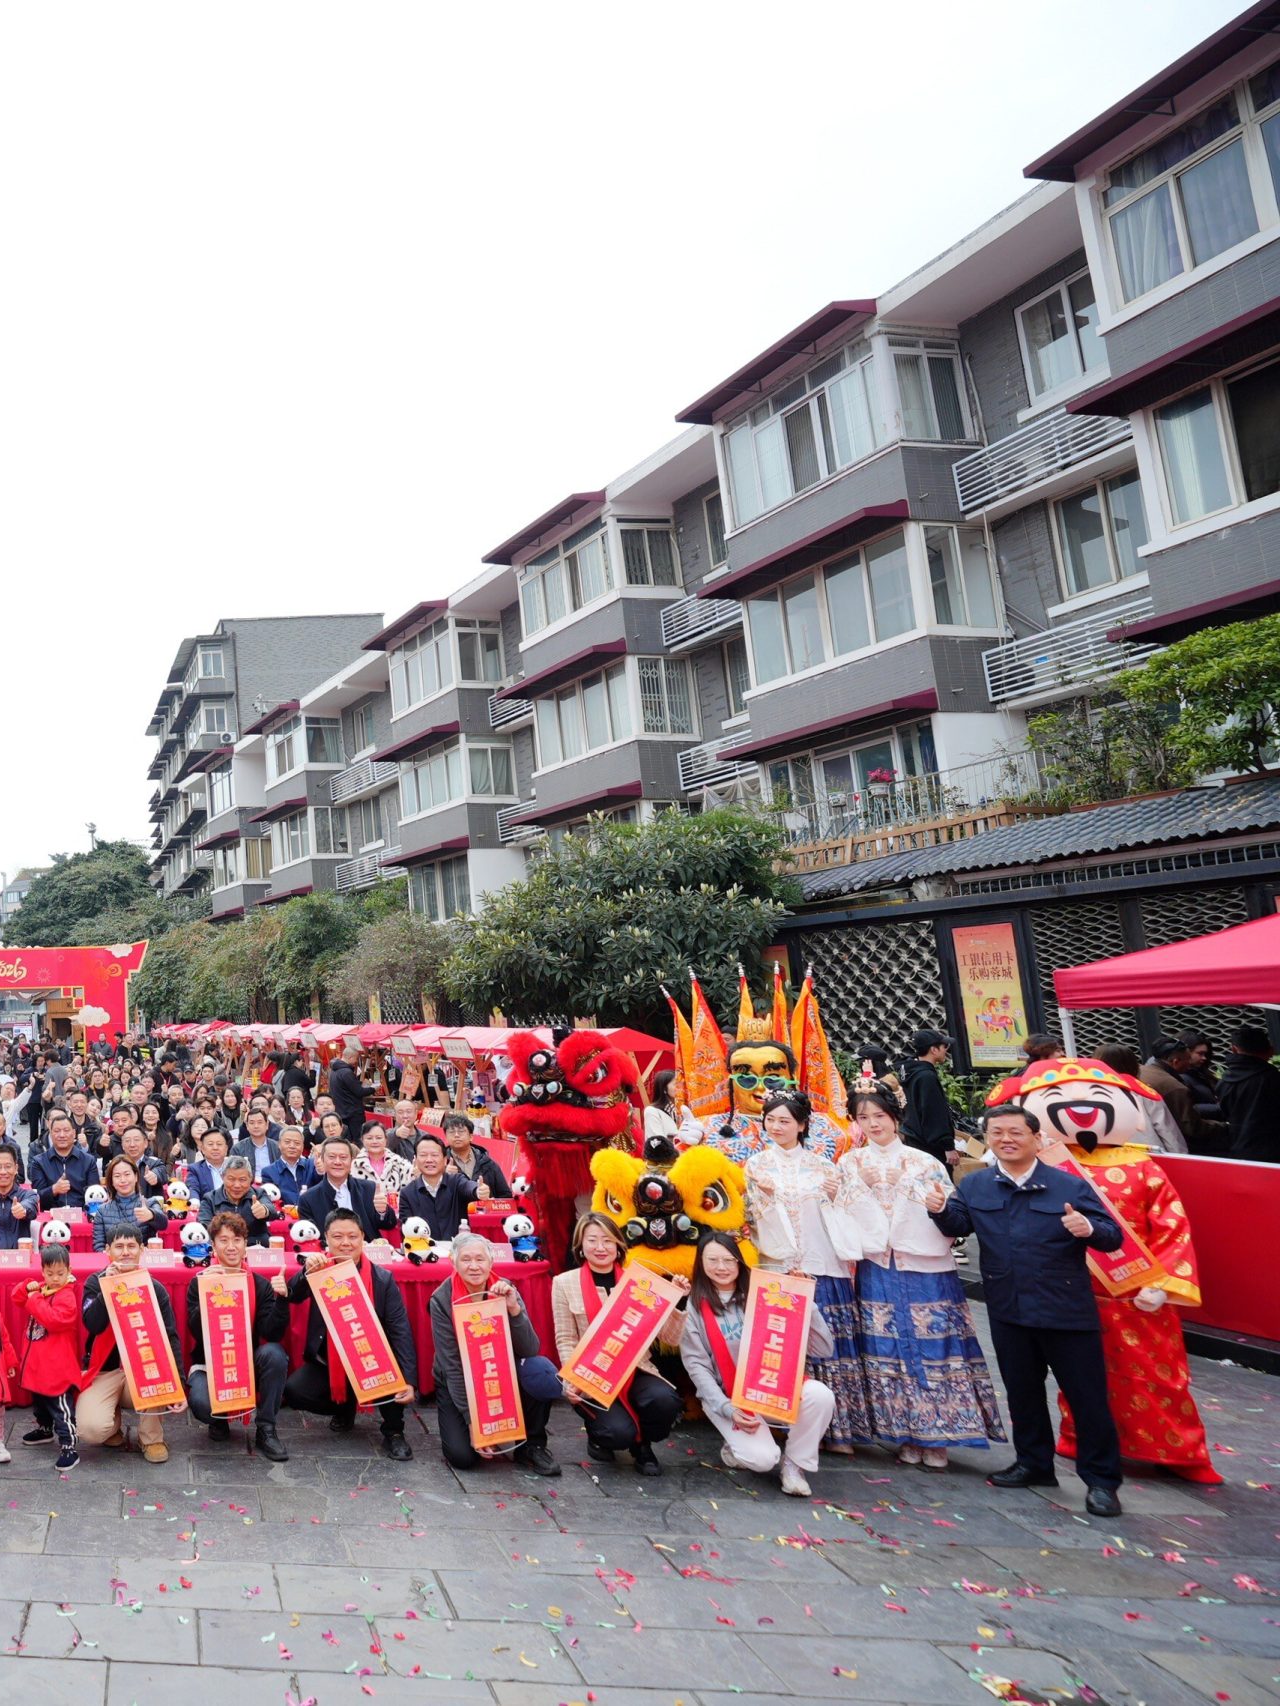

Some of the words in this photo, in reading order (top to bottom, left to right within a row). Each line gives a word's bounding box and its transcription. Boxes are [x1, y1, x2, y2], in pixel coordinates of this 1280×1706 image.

[960, 950, 1014, 966] 工银信用卡
[361, 1371, 395, 1390] 2026
[574, 1364, 612, 1393] 2026
[140, 1382, 174, 1398] 2026
[218, 1387, 248, 1401] 2026
[745, 1388, 789, 1411] 2026
[482, 1418, 517, 1435] 2026
